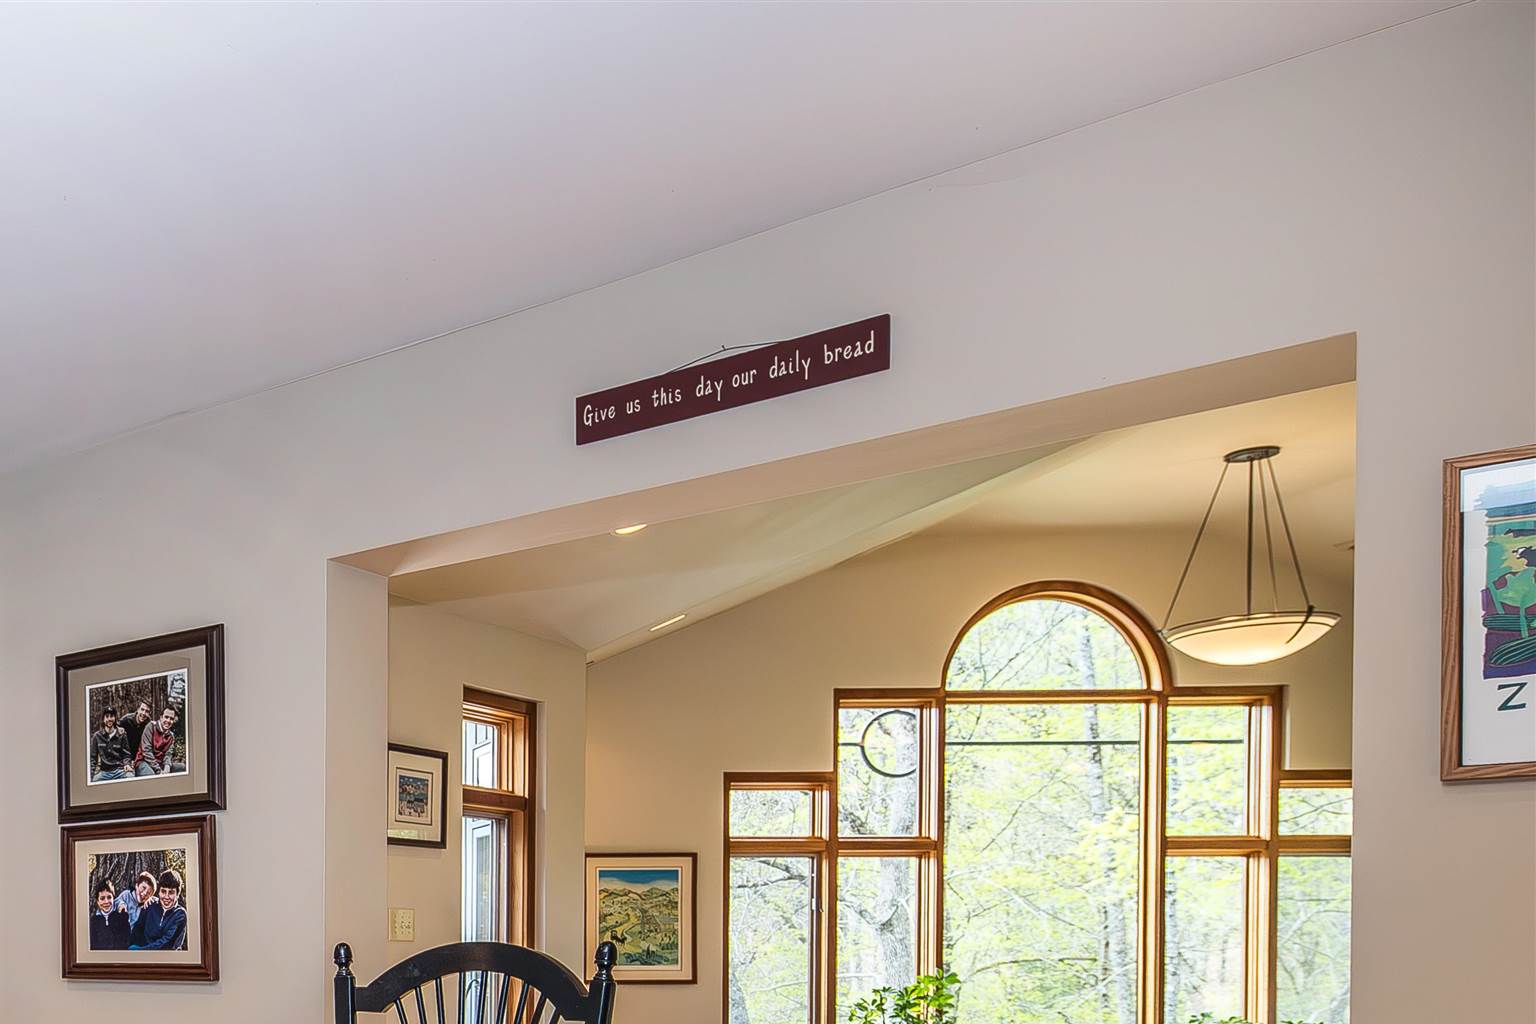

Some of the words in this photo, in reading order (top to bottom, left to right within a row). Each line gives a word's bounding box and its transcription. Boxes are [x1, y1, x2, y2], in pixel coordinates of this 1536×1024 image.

[583, 403, 616, 427] Give
[626, 398, 641, 415] us
[651, 386, 682, 408] this
[695, 375, 724, 402] day
[731, 368, 758, 388] our
[768, 350, 811, 381] daily
[823, 330, 875, 365] bread
